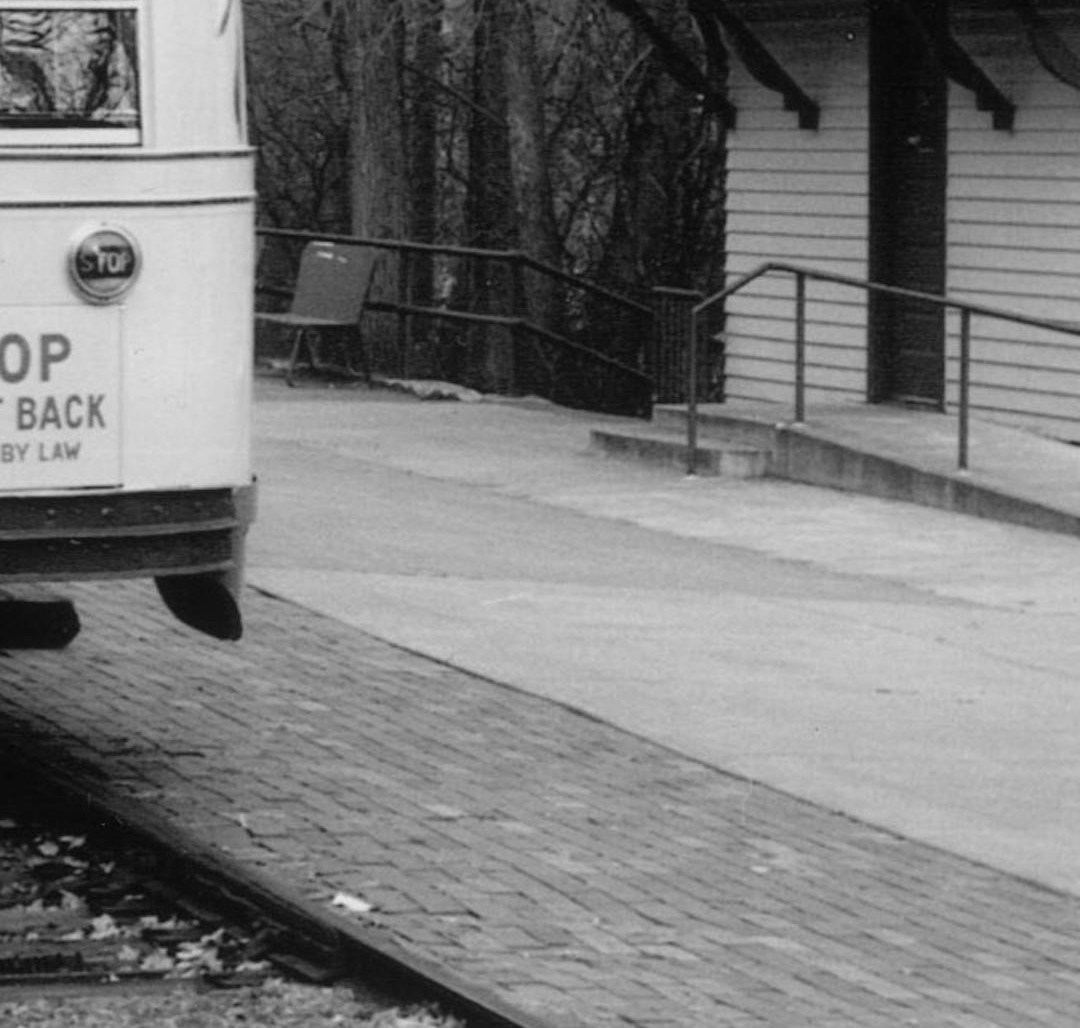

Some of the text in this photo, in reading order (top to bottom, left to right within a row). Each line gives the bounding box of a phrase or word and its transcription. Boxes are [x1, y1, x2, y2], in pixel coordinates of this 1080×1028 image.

[17, 394, 106, 430] BACK
[1, 443, 29, 463] BY
[40, 441, 81, 461] LAW
